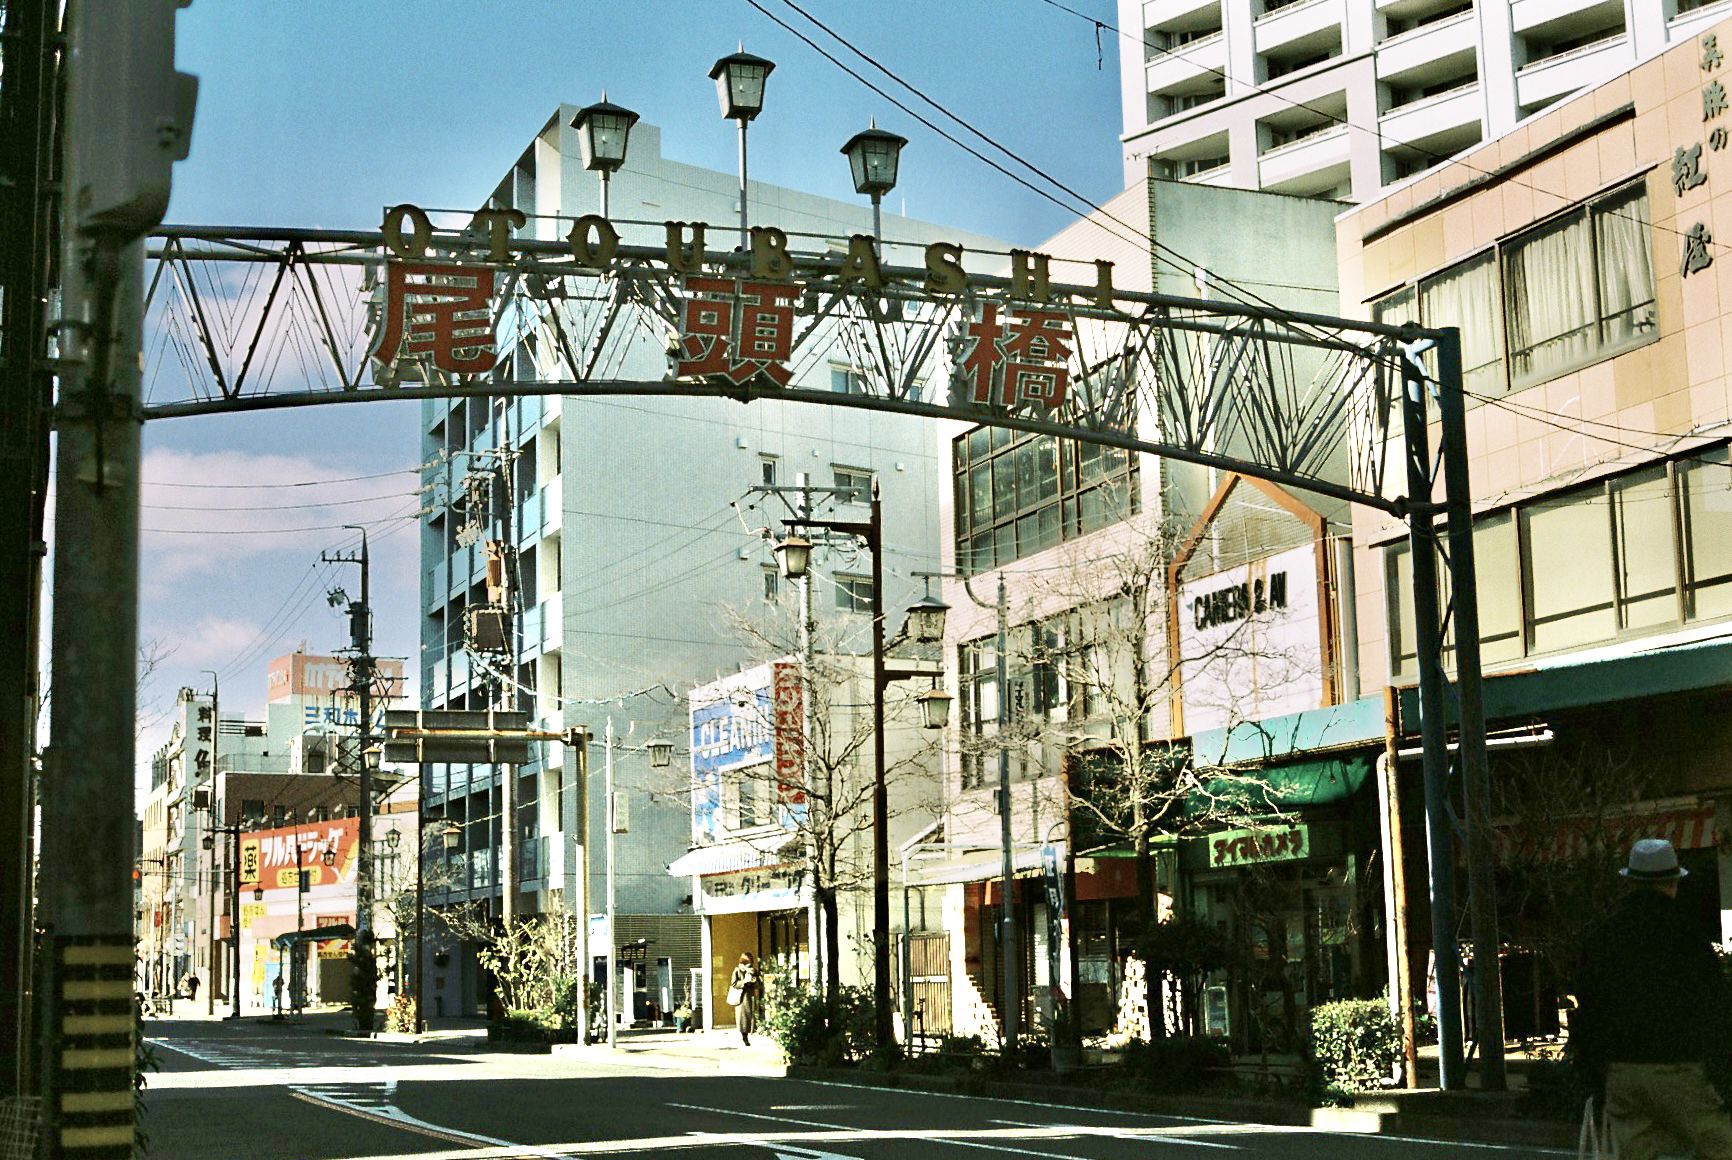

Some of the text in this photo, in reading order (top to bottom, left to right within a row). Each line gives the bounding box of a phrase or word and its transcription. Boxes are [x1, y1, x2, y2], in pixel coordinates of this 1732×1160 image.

[378, 203, 1117, 310] OTOUBASHI
[368, 260, 1074, 408] 尾頭橋
[1194, 583, 1251, 632] CAMERA
[701, 702, 771, 760] CLEANIN
